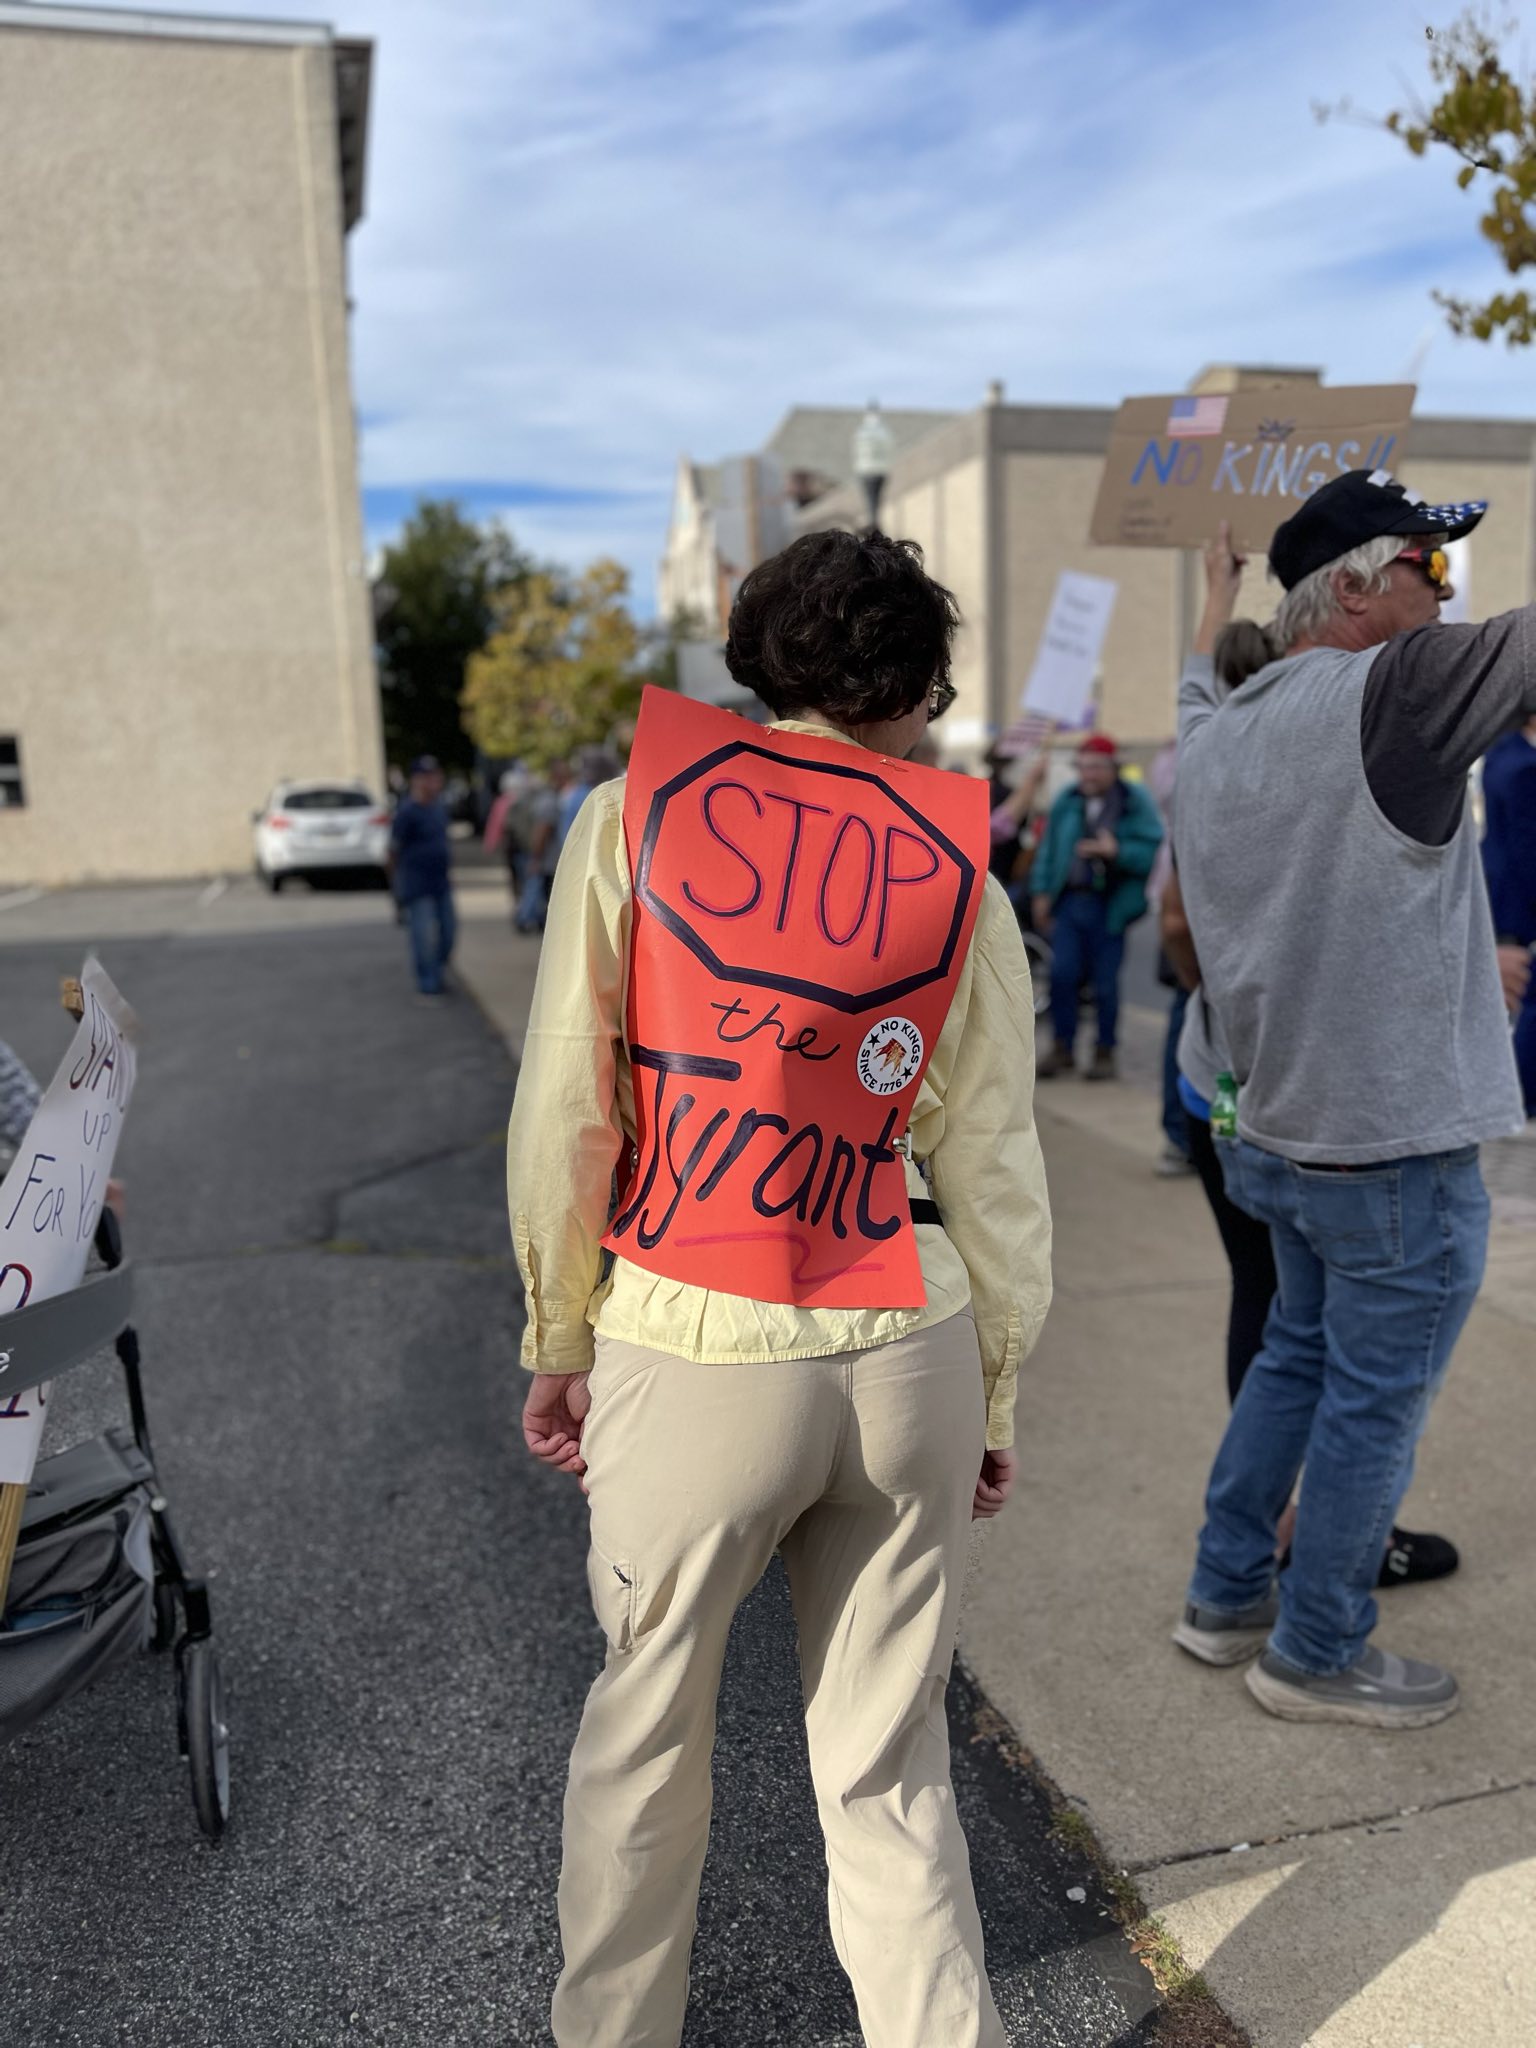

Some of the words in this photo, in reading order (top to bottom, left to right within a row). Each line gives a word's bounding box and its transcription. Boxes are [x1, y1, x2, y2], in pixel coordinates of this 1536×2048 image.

[1129, 440, 1203, 486] NO
[681, 776, 941, 961] STOP
[711, 997, 840, 1061] the
[880, 1020, 899, 1034] NO
[901, 1022, 921, 1064] KINGS
[859, 1048, 878, 1089] SINCE
[878, 1078, 903, 1093] 1776
[83, 1110, 112, 1153] UP
[612, 1044, 902, 1250] Tyrant
[5, 1153, 65, 1237] FOR
